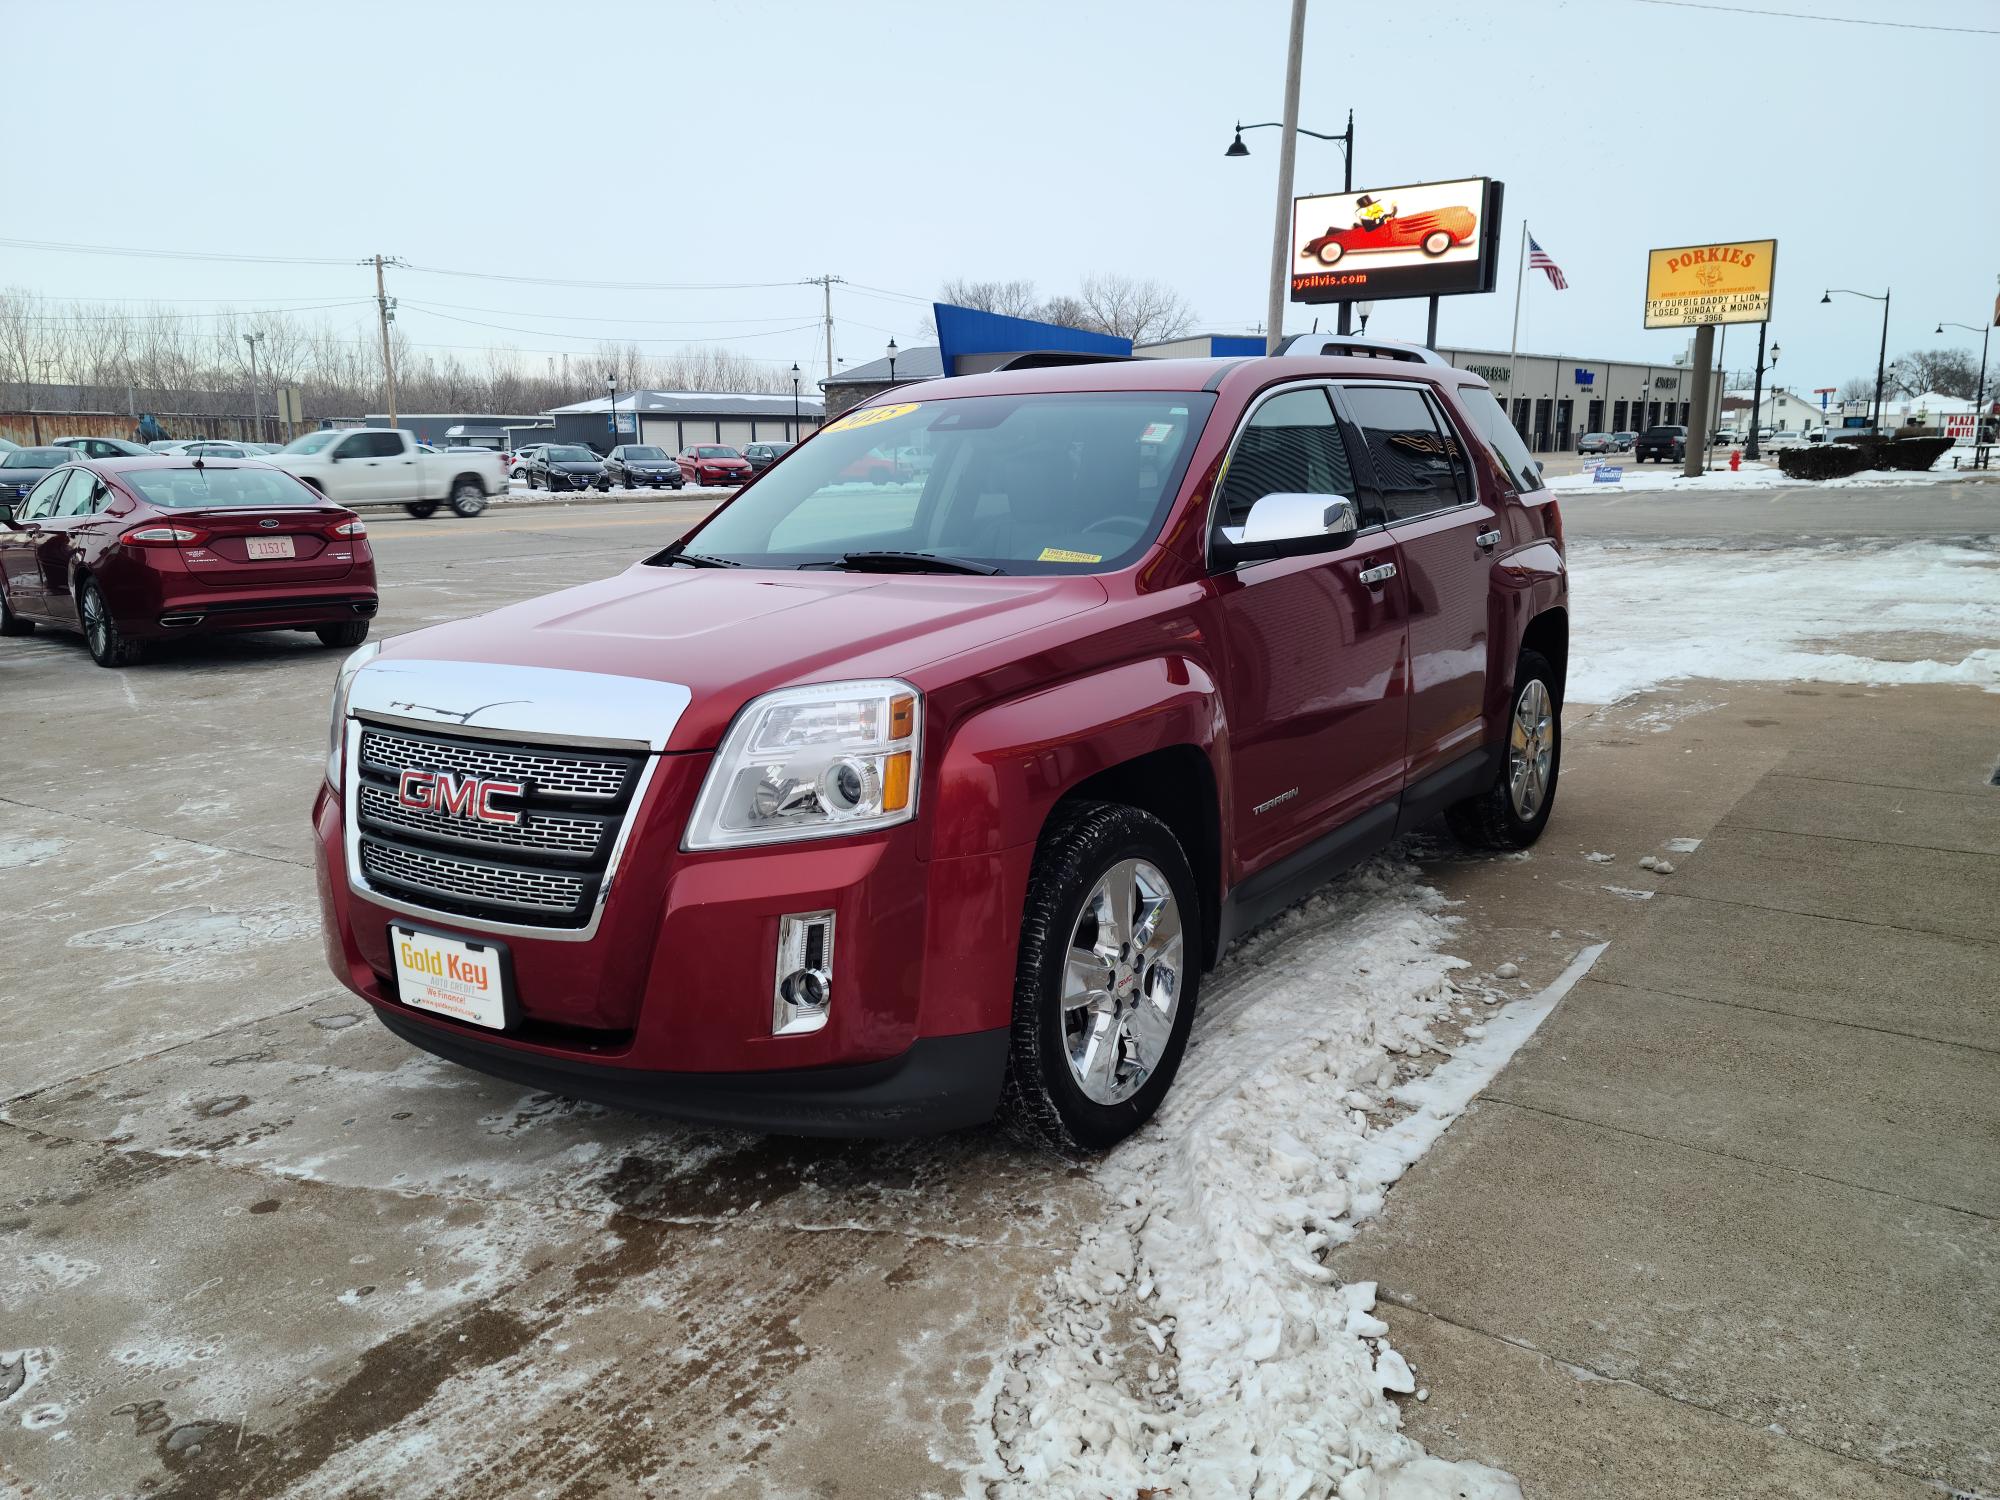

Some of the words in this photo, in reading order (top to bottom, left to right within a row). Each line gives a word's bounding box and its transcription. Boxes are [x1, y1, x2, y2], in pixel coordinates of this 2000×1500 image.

[1666, 247, 1756, 274] PORKIES
[1647, 300, 1663, 308] TRY
[1700, 296, 1729, 305] DADDY
[1683, 304, 1717, 315] SUNDAY
[1720, 304, 1727, 312] &
[1730, 302, 1768, 312] MONDAY
[1948, 415, 1975, 426] PLAZA
[1947, 427, 1974, 437] MOTEL
[399, 767, 526, 826] GMC
[1252, 786, 1299, 816] TERRAIN
[401, 942, 443, 977] Gold
[446, 953, 489, 991] Key
[430, 976, 448, 989] AUTO
[450, 981, 476, 995] CREDIT
[1117, 974, 1133, 989] GMC
[426, 986, 437, 998] We
[438, 990, 466, 1006] Finance!
